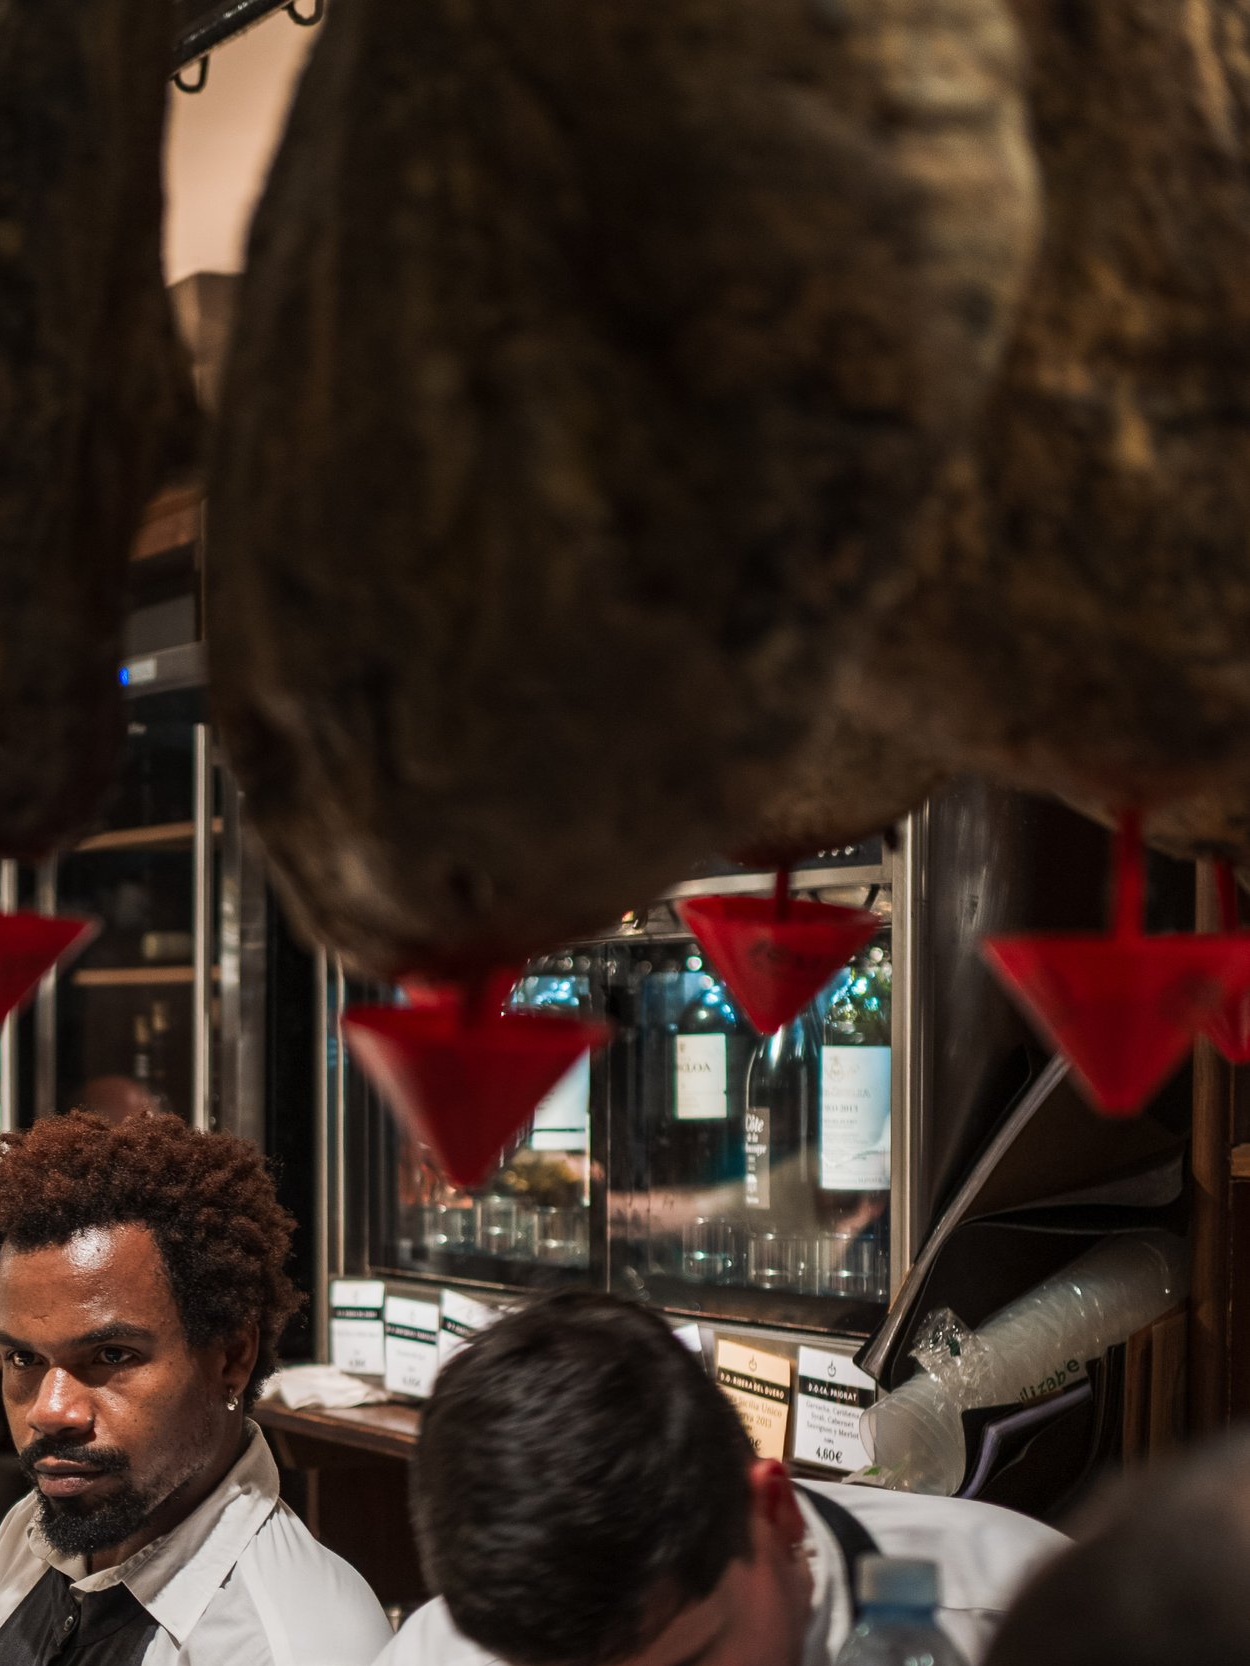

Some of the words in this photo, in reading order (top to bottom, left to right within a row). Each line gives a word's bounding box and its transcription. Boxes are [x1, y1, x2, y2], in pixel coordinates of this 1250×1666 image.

[830, 1388, 857, 1401] PRIORAT
[838, 1428, 860, 1440] Merlot
[815, 1446, 843, 1464] 4,60€
